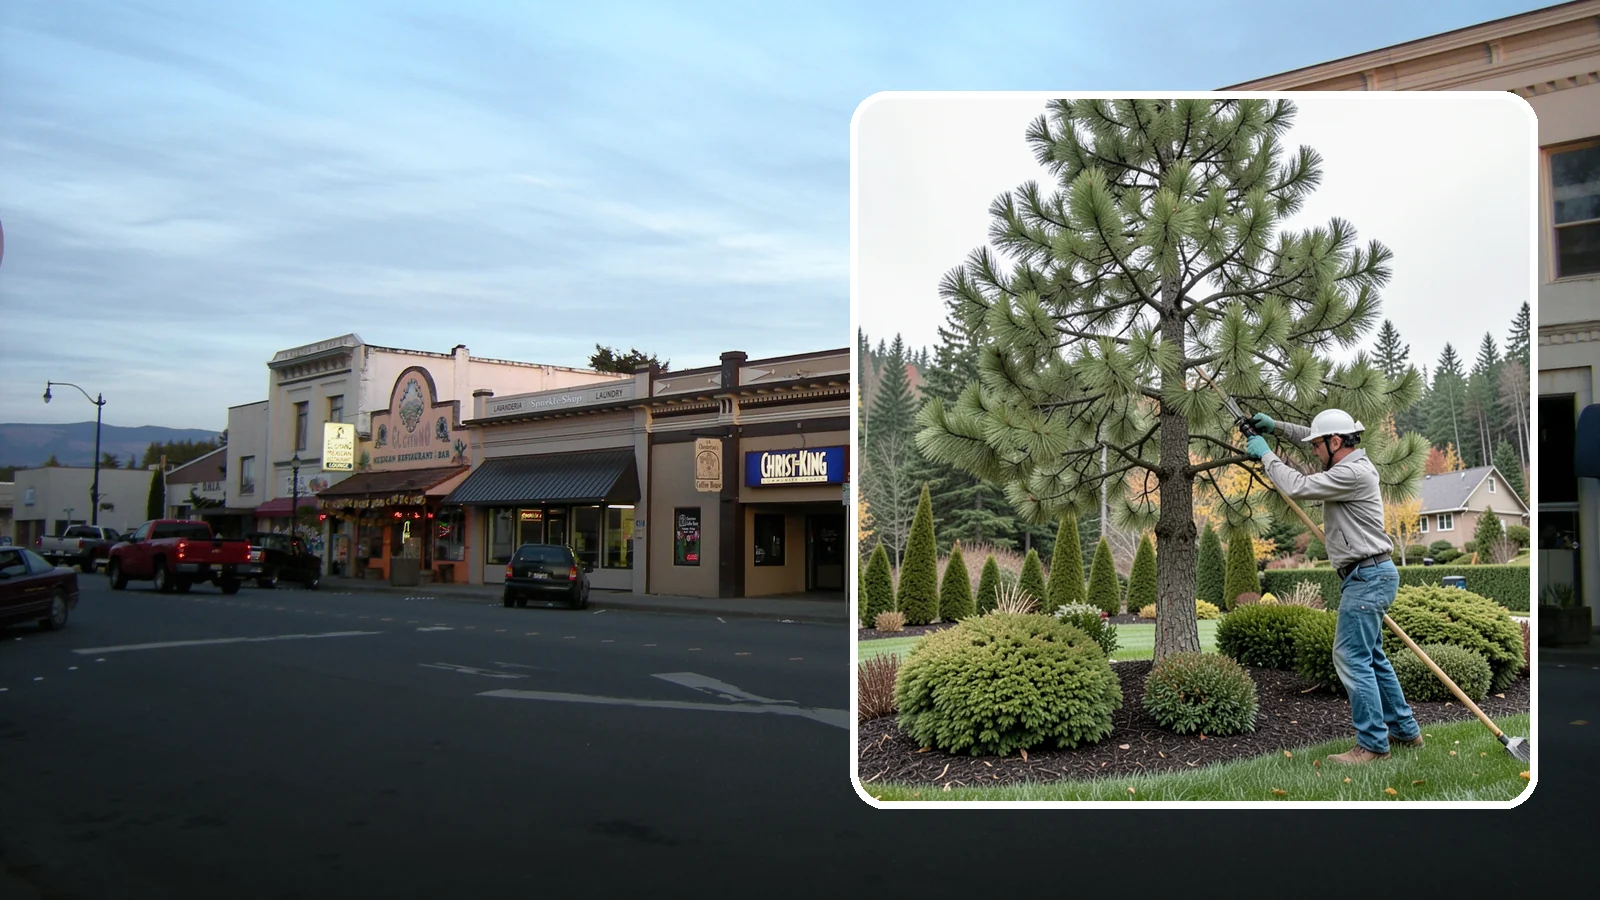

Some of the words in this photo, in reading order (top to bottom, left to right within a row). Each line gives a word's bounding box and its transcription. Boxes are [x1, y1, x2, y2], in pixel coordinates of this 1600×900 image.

[562, 394, 582, 404] Shop
[595, 389, 623, 399] LAUNDRY
[493, 402, 522, 412] LAVANDERIA
[373, 454, 396, 464] MEXICAN
[397, 451, 433, 462] RESTAURANT
[438, 450, 450, 459] BAR
[761, 452, 797, 478] CHRIST
[799, 450, 827, 476] KING
[696, 481, 709, 489] Coffee
[710, 481, 722, 489] House
